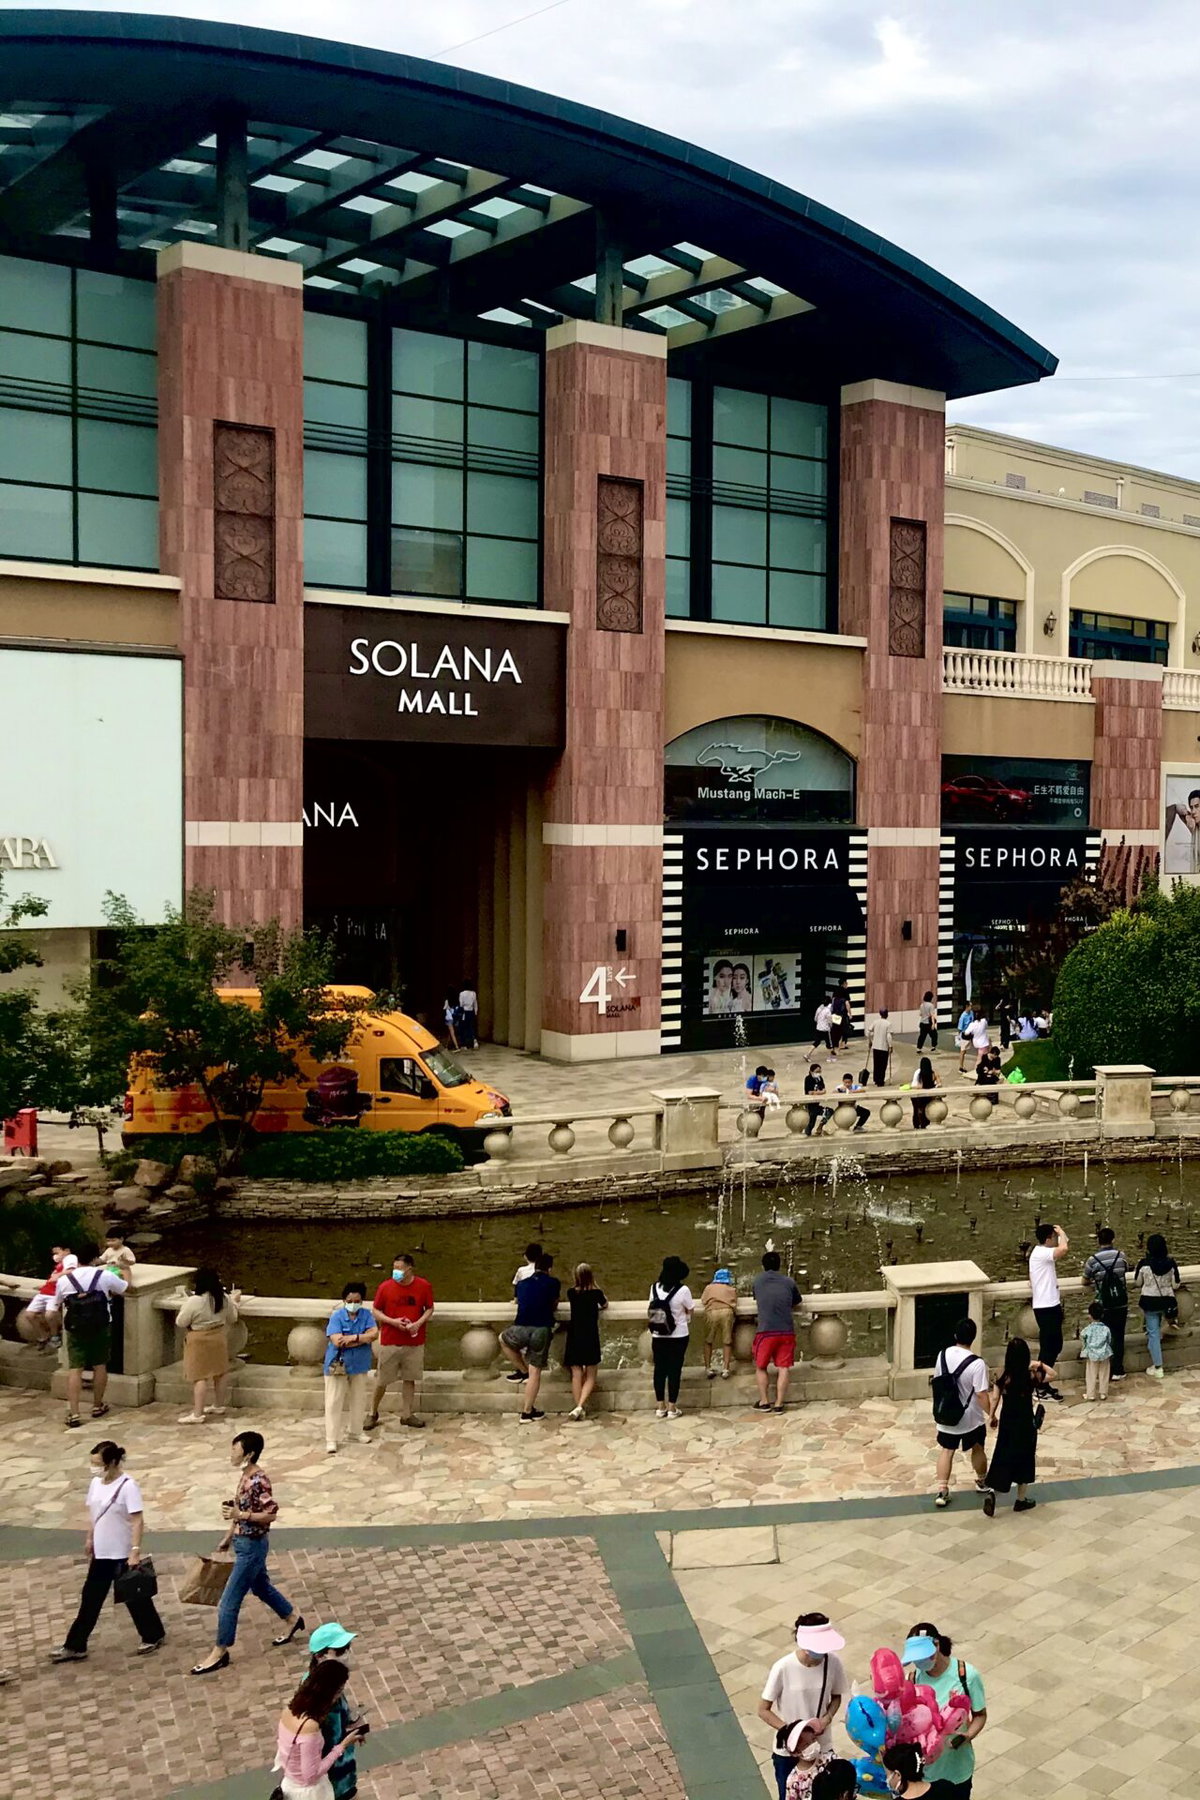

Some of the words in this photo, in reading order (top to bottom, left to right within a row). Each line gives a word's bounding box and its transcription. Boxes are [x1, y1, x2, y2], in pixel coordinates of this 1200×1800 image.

[349, 638, 523, 684] SOLANA
[398, 688, 479, 717] MALL
[697, 786, 751, 801] Mustang
[754, 787, 801, 800] Mach-E
[696, 847, 840, 871] SEPHORA
[965, 847, 1079, 868] SEPHORA
[724, 928, 760, 936] SEPHORA
[809, 925, 843, 933] SEPHORA
[579, 966, 612, 1015] 4
[606, 1004, 637, 1012] SOLANA
